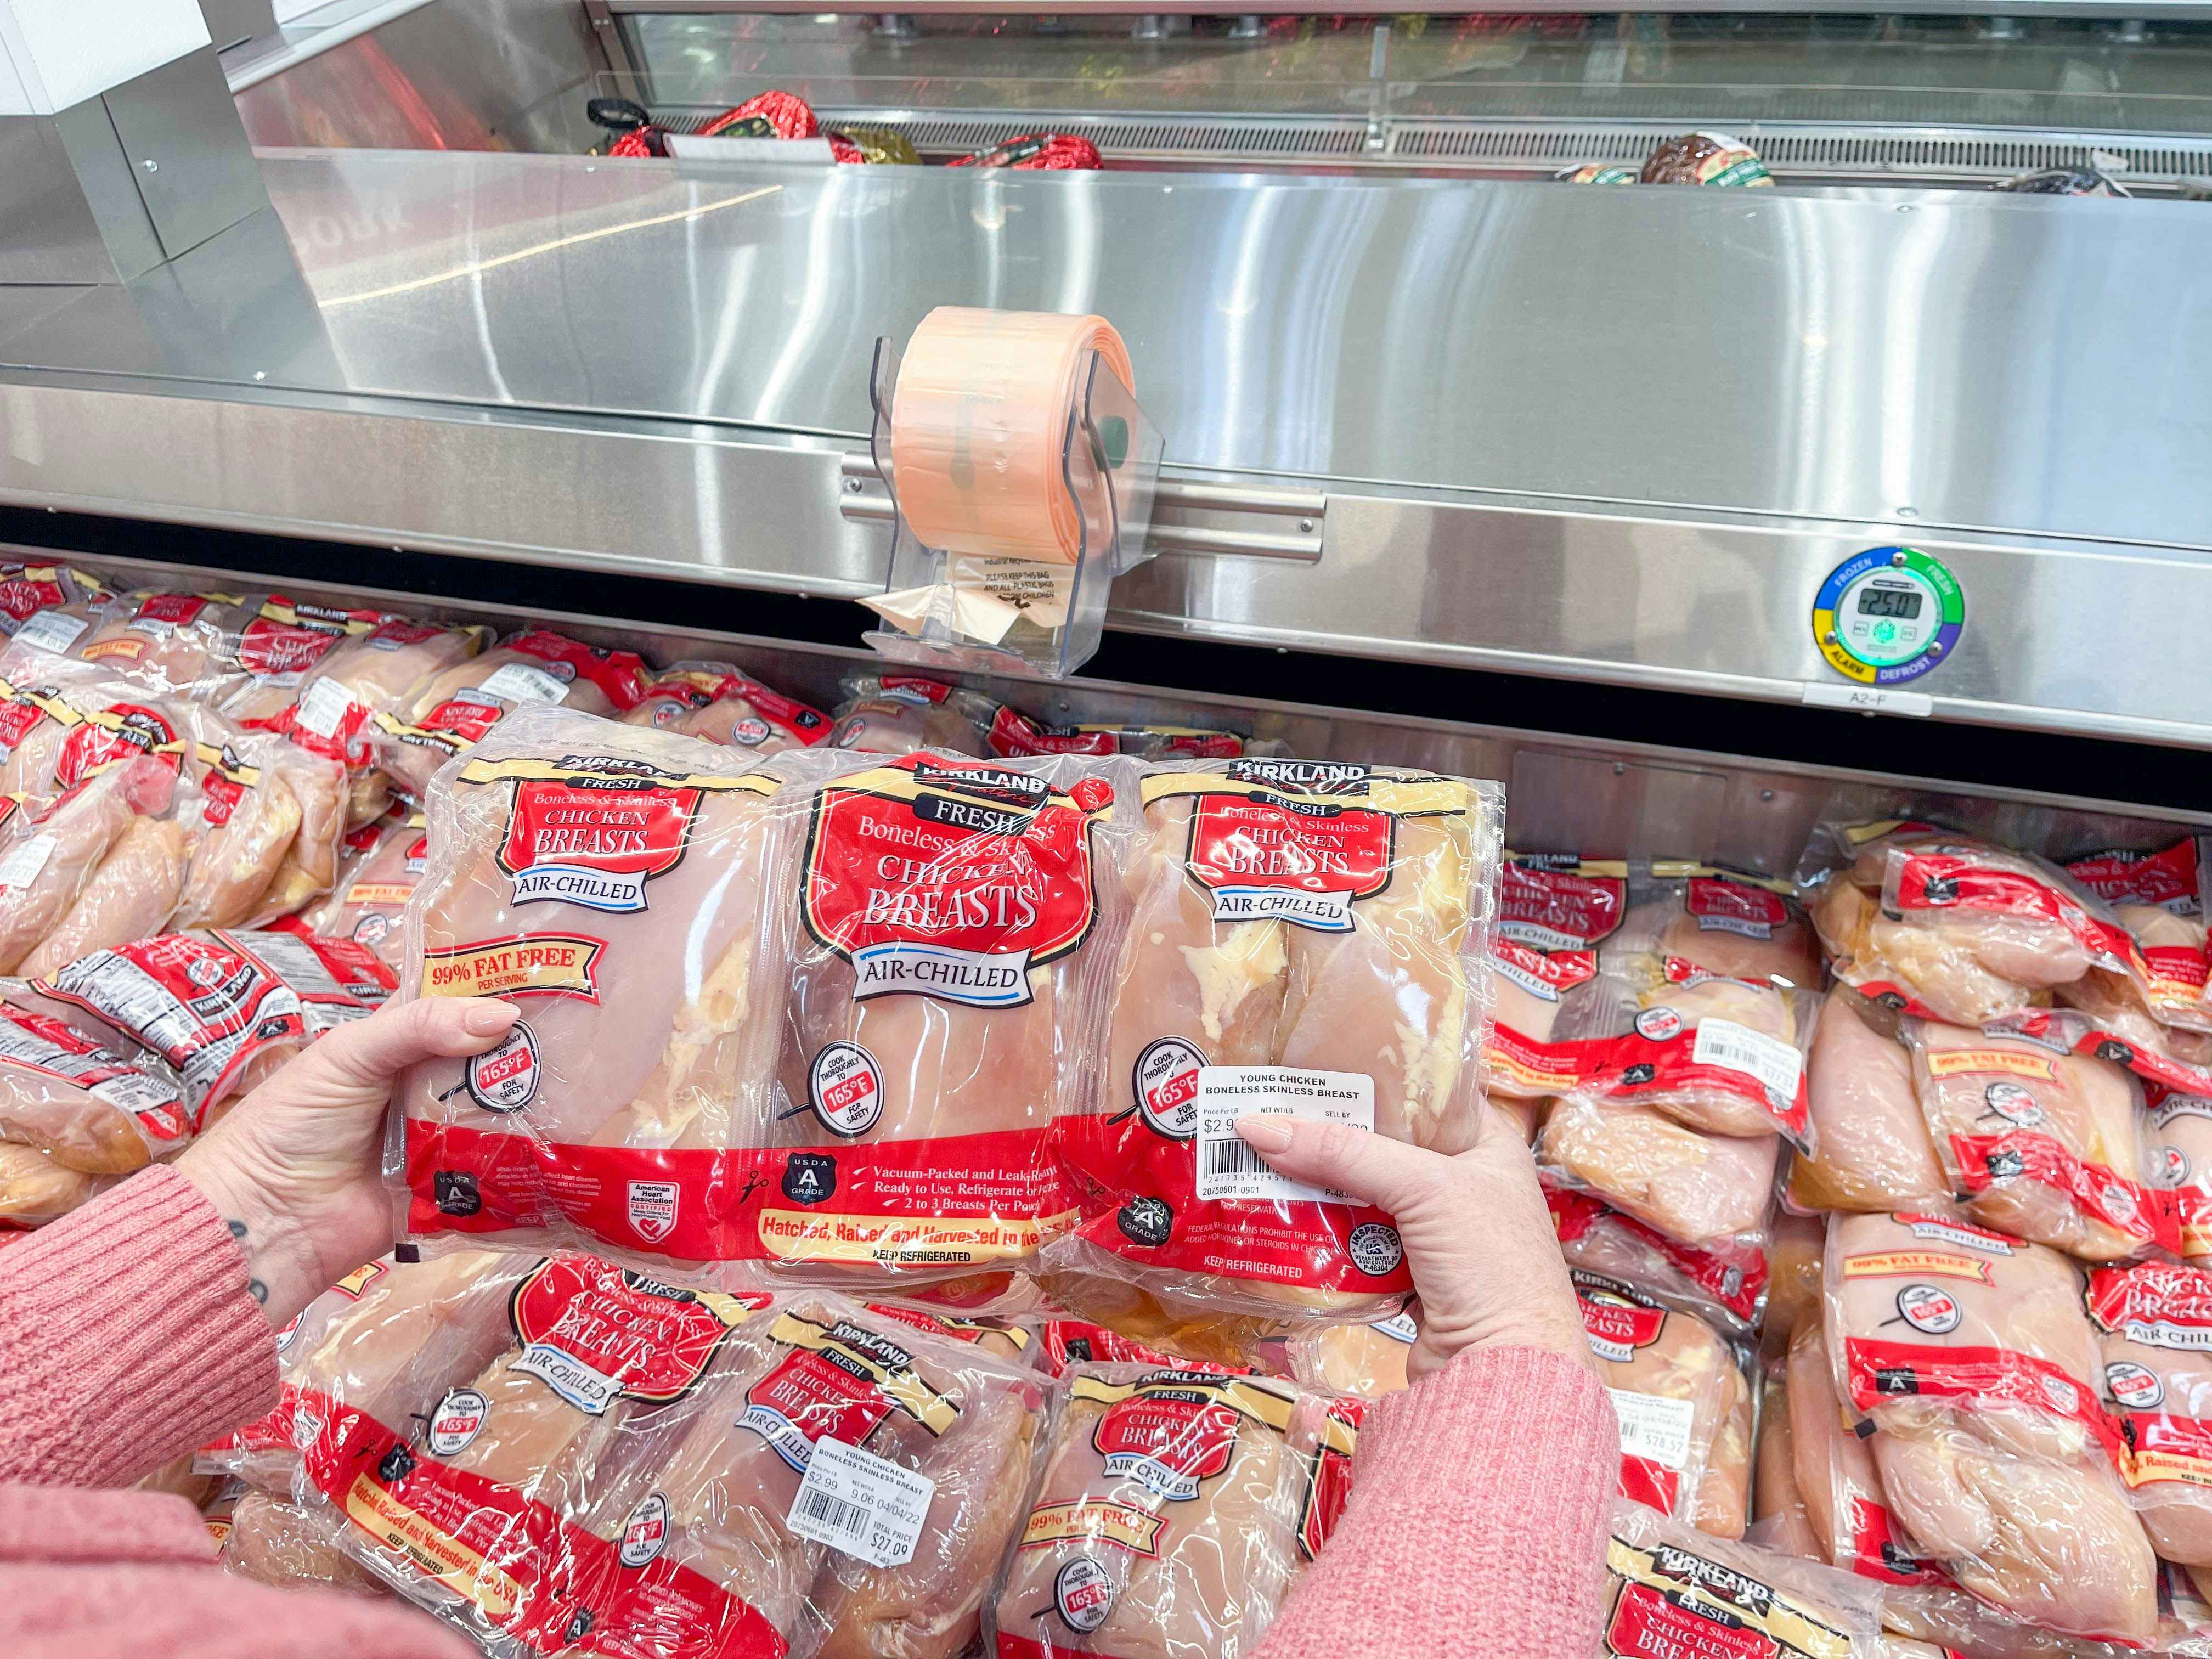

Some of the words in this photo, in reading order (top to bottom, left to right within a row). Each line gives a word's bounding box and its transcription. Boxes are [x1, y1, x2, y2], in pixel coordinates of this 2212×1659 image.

[1023, 571, 1036, 579] THIS
[1037, 571, 1049, 579] BAG
[1834, 556, 1873, 588] FROZEN
[1926, 564, 1955, 595] FRESH
[1013, 582, 1036, 590] PLASTIC
[1023, 590, 1054, 599] CHILDREN
[1831, 650, 1864, 675] ALARM
[1880, 657, 1931, 680] DEFROST
[1850, 692, 1887, 705] A2-F
[923, 765, 1046, 793] KIRKLAND
[1235, 760, 1365, 782] KIRKLAND
[581, 778, 642, 789] FRESH
[534, 792, 595, 805] Boneless
[1265, 793, 1327, 816] FRESH
[544, 810, 650, 826] CHICKEN
[934, 799, 1015, 834] FRESH
[1220, 806, 1285, 822] Boneless
[1306, 820, 1369, 833] Skinless
[533, 829, 649, 854] BREASTS
[858, 815, 954, 854] Boneless
[1236, 825, 1347, 849] CHICKEN
[877, 848, 1030, 887] CHICKEN
[1229, 848, 1350, 876] BREASTS
[517, 875, 637, 901] AIR-CHILLED
[862, 884, 1037, 929] BREASTS
[1218, 896, 1344, 919] AIR-CHILLED
[1500, 926, 1581, 950] AIR-CHILLED
[432, 961, 472, 986] 99%
[475, 952, 512, 974] FAT
[516, 947, 577, 968] FREE
[864, 959, 1018, 988] AIR-CHILLED
[194, 965, 252, 1013] KIRKLAND
[477, 979, 493, 990] PER
[494, 972, 528, 988] SERVING
[498, 1049, 508, 1057] TO
[827, 1054, 845, 1068] COOK
[1153, 1051, 1173, 1066] COOK
[482, 1052, 527, 1084] 165°F
[820, 1056, 860, 1082] THOROUGHLY
[837, 1072, 846, 1081] TO
[502, 1079, 517, 1091] FOR
[1240, 1074, 1276, 1083] YOUNG
[1279, 1075, 1327, 1086] CHICKEN
[500, 1084, 524, 1098] SAFETY
[827, 1076, 868, 1107] 165°F
[1153, 1074, 1197, 1108] 165°F
[1205, 1085, 1260, 1094] BONELESS
[1262, 1085, 1314, 1096] SKINLESS
[1317, 1089, 1361, 1100] BREAST
[846, 1107, 870, 1124] SAFETY
[1177, 1103, 1194, 1116] FOR
[1325, 1110, 1341, 1119] SELL
[794, 1158, 828, 1167] USDA
[874, 1165, 968, 1180] Vacuum-Packed
[972, 1167, 996, 1180] and
[635, 1184, 670, 1192] American
[798, 1168, 820, 1187] A
[448, 1187, 463, 1200] A
[631, 1195, 673, 1204] Association
[791, 1187, 825, 1197] GRADE
[874, 1180, 913, 1196] Ready
[916, 1182, 927, 1193] to
[930, 1182, 955, 1197] Use,
[958, 1183, 1024, 1199] Refrigerate
[1026, 1187, 1037, 1197] or
[1202, 1185, 1237, 1196] 20750601
[1240, 1186, 1260, 1195] 0901
[904, 1198, 912, 1208] 2
[915, 1198, 927, 1209] to
[930, 1198, 940, 1209] 3
[942, 1199, 986, 1211] Breasts
[989, 1199, 1009, 1211] Per
[1221, 1200, 1232, 1210] NO
[515, 1215, 540, 1226] KEEP
[762, 1216, 831, 1240] Hatched,
[836, 1221, 883, 1242] Raised
[891, 1225, 919, 1242] and
[923, 1226, 998, 1245] Harvested
[1002, 1229, 1018, 1245] in
[1132, 1210, 1155, 1231] A
[1214, 1221, 1258, 1235] REGULATIONS
[1259, 1227, 1293, 1239] PROHIBIT
[1294, 1231, 1307, 1241] THE
[1124, 1221, 1158, 1242] GRADE
[1351, 1226, 1398, 1247] INSPECTED
[1184, 1234, 1207, 1244] ADDED
[1243, 1237, 1254, 1245] OR
[1256, 1238, 1289, 1250] STEROIDS
[1291, 1242, 1299, 1251] IN
[899, 1250, 972, 1262] REFRIGERATED
[1204, 1254, 1224, 1268] KEEP
[1226, 1260, 1303, 1279] REFRIGERATED
[825, 1348, 866, 1377] FRESH
[524, 1350, 607, 1401] AIR-CHILLED
[1153, 1390, 1198, 1402] FRESH
[768, 1379, 845, 1435] BREASTS
[1166, 1404, 1177, 1413] &
[441, 1418, 477, 1432] 165°F
[818, 1448, 857, 1469] BONELESS
[858, 1463, 895, 1483] SKINLESS
[895, 1478, 924, 1496] BREAST
[844, 1449, 871, 1465] YOUNG
[872, 1460, 906, 1480] CHICKEN
[2145, 1455, 2188, 1470] Raised
[807, 1471, 838, 1491] $2.99
[850, 1488, 874, 1505] 9.06
[876, 1498, 921, 1525] 04/04/22
[1030, 1515, 1063, 1531] 99%
[1066, 1509, 1098, 1524] FAT
[386, 1531, 406, 1548] KEEP
[789, 1520, 818, 1537] 20750601
[818, 1531, 834, 1542] 0903
[872, 1520, 892, 1534] TOTAL
[891, 1528, 913, 1543] PRICE
[870, 1532, 909, 1556] $27.09
[1072, 1566, 1088, 1576] COOK
[1661, 1547, 1770, 1601] KIRKLAND
[571, 1620, 583, 1634] A
[1693, 1621, 1705, 1633] &
[1708, 1626, 1761, 1656] Skinless
